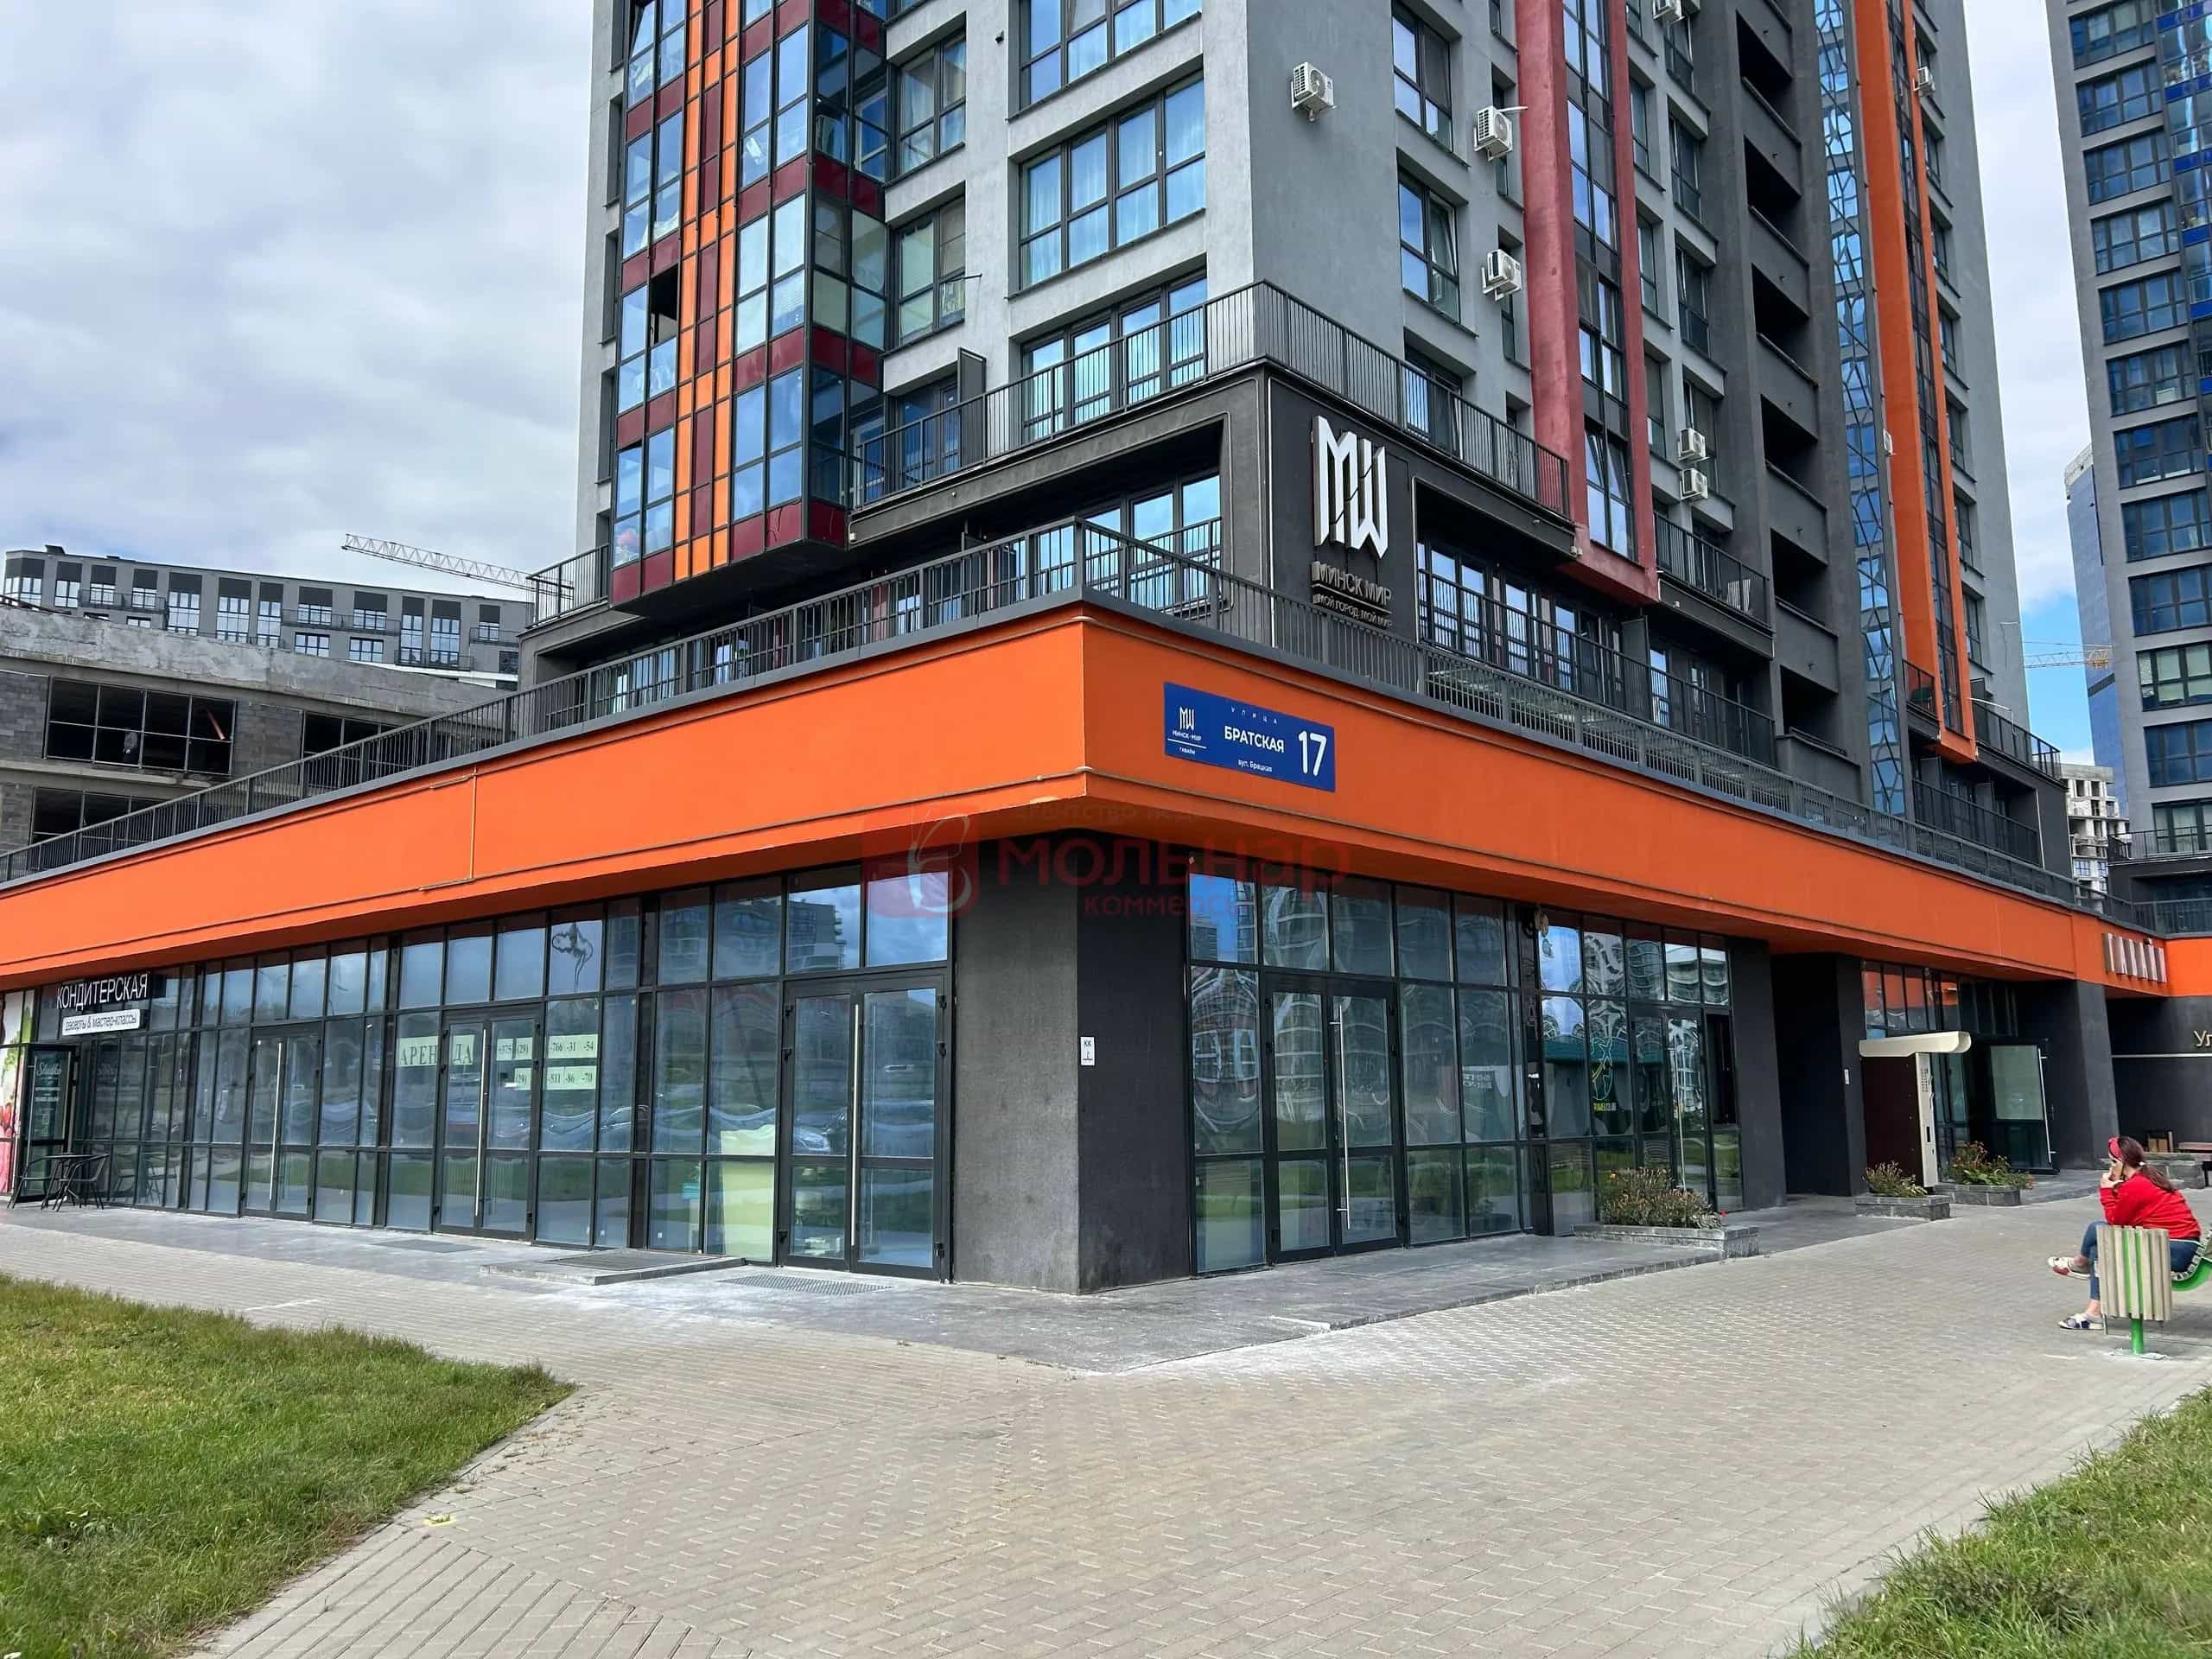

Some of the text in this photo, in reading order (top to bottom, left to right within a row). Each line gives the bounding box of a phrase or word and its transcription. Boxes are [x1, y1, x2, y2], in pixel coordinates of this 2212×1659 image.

[1313, 561, 1392, 606] МИНСК МИР
[1224, 726, 1285, 753] БРАТСКАЯ
[1298, 730, 1327, 777] 17
[56, 974, 148, 1011] КОНДИТЕРСКАЯ
